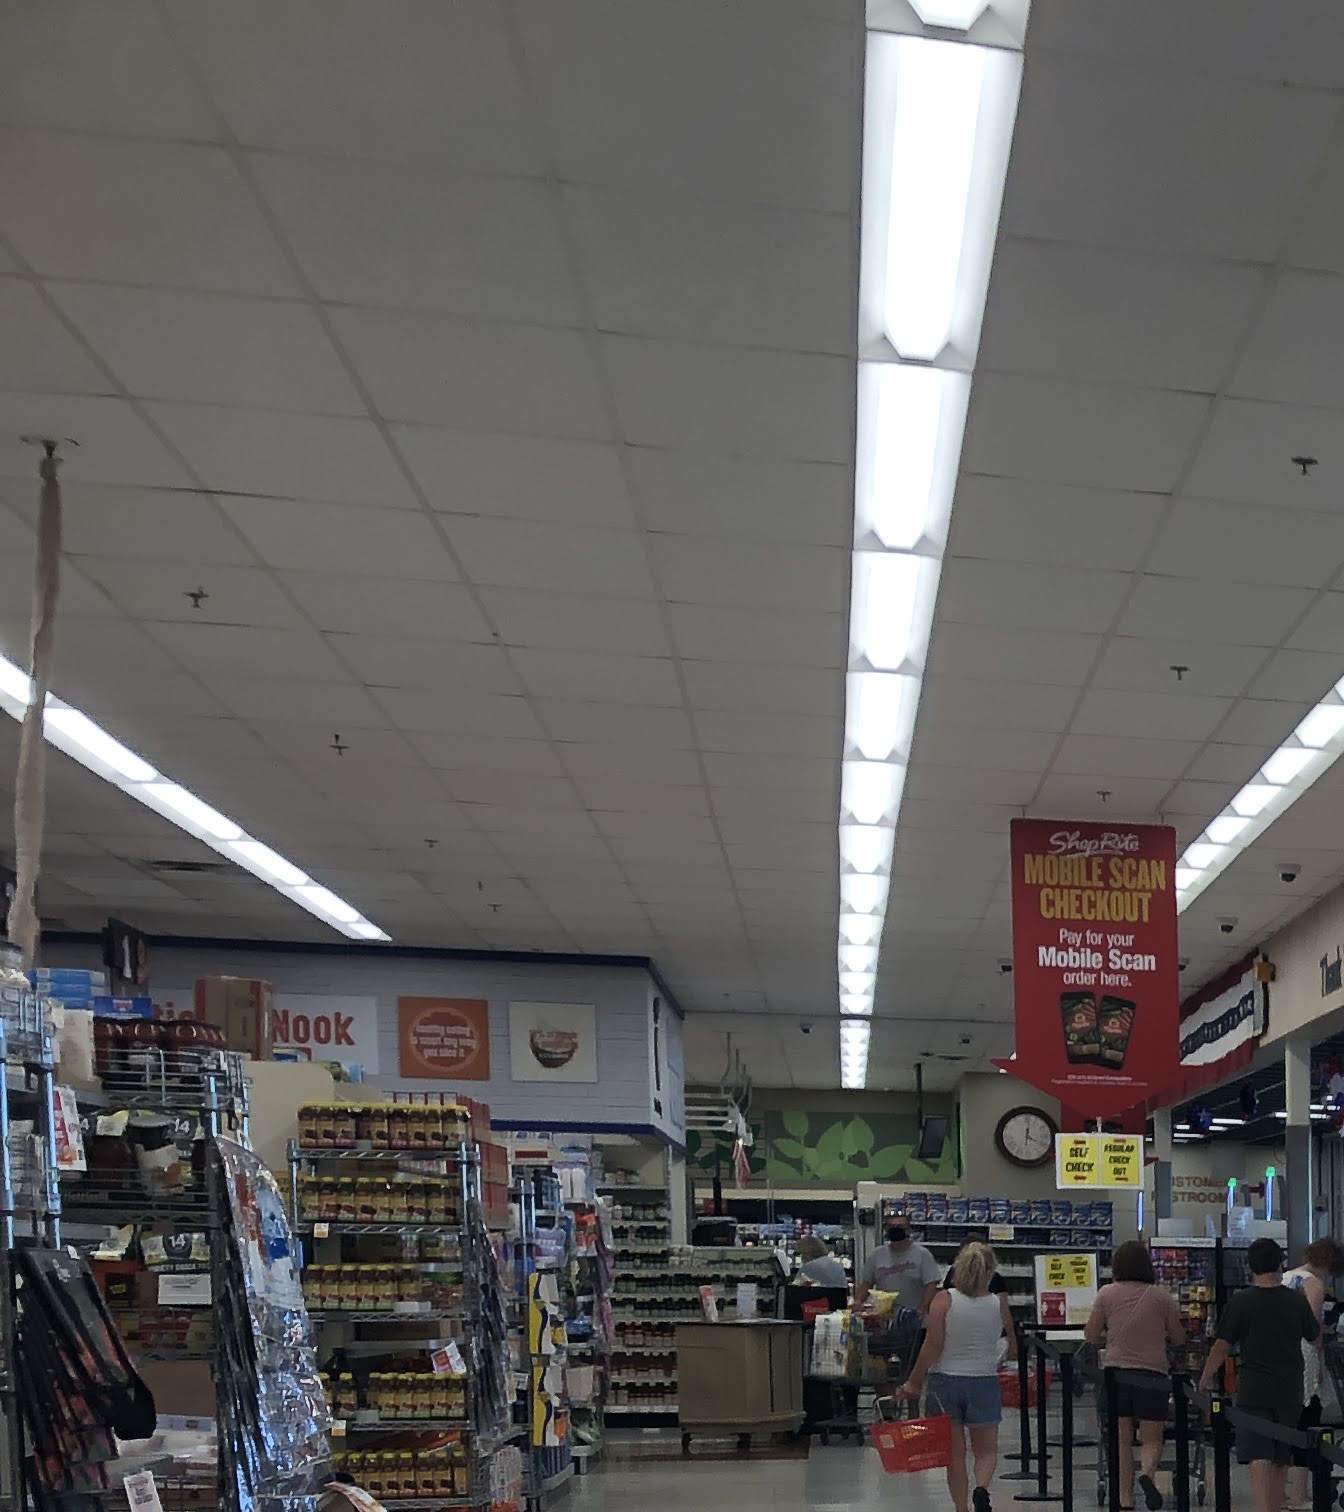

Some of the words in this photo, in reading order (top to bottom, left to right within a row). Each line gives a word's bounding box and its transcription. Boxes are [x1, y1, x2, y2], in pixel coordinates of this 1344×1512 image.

[1048, 830, 1140, 858] ShopRite
[1024, 853, 1104, 887] MOBILE
[1109, 858, 1167, 891] SCAN
[1040, 888, 1152, 923] CHECKOUT
[1059, 928, 1082, 947] Pay
[1086, 929, 1103, 945] for
[1107, 934, 1135, 948] your
[1038, 946, 1103, 969] Mobile
[1108, 948, 1156, 971] Scan
[1063, 970, 1097, 985] order
[1100, 971, 1132, 987] here.
[272, 1008, 355, 1046] Nook
[1065, 1162, 1095, 1173] CHECK
[169, 1233, 187, 1249] 14
